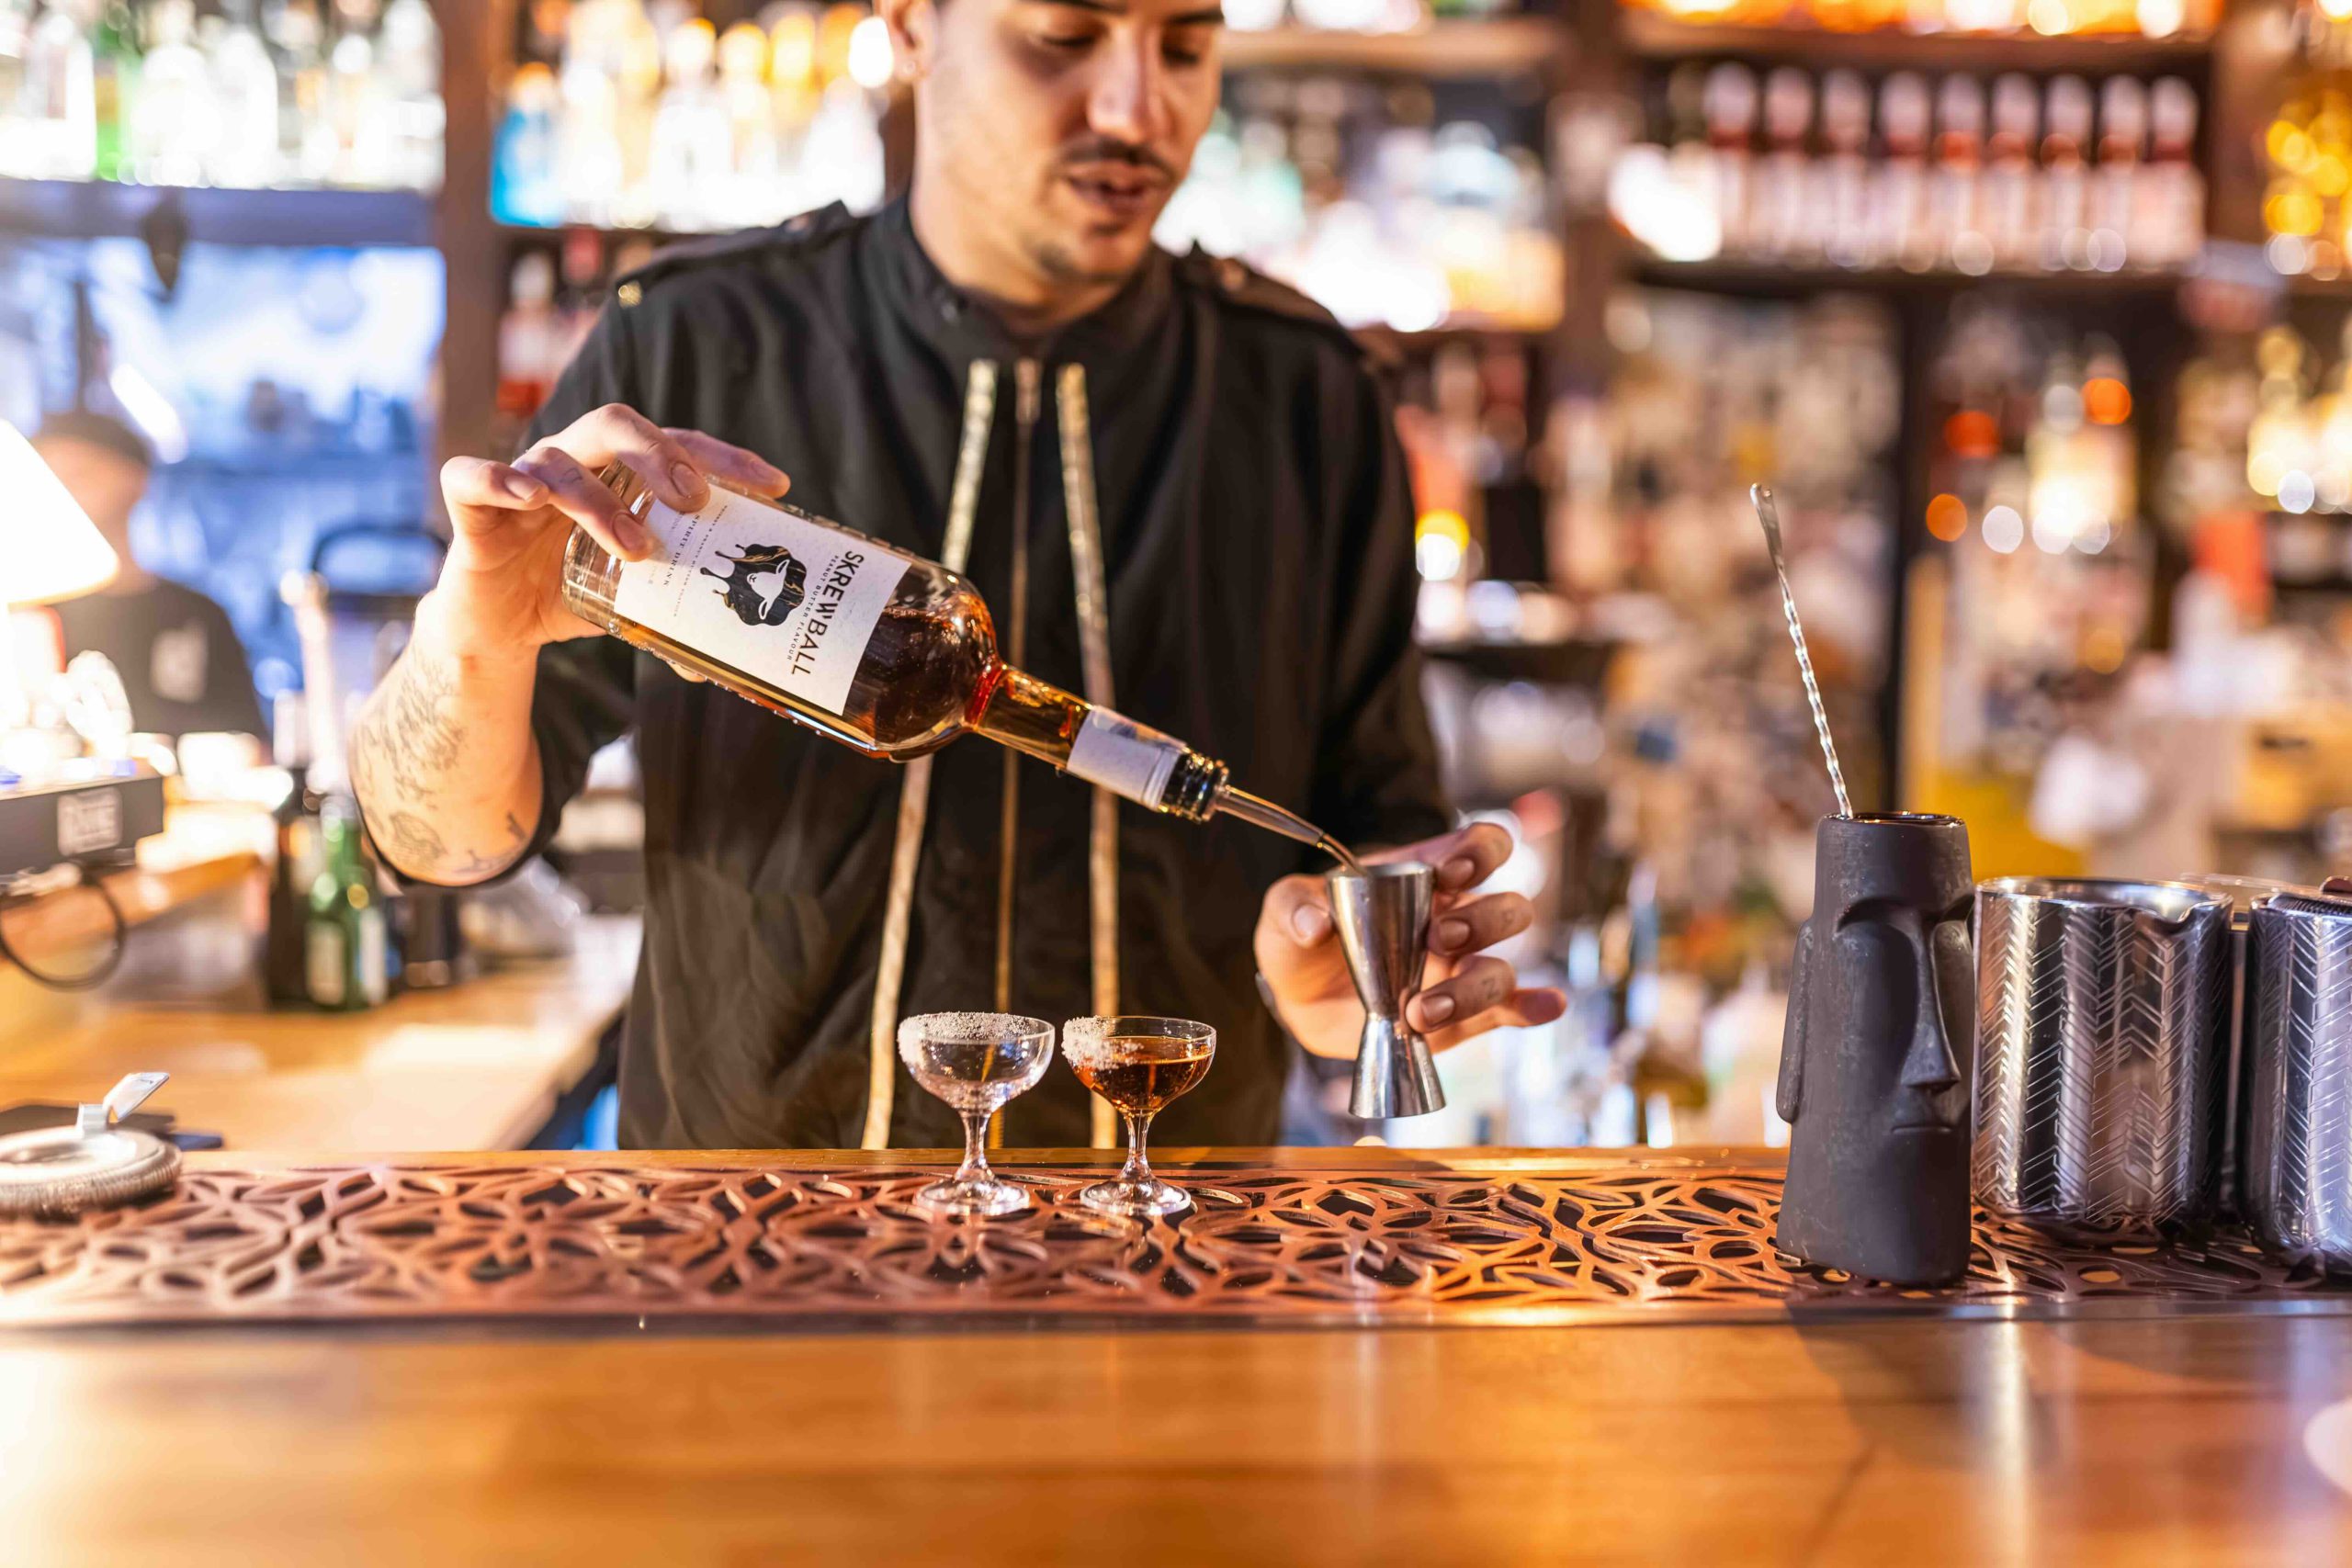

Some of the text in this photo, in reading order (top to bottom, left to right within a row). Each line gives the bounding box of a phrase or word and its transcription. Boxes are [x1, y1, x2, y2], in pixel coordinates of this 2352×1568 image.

[679, 514, 700, 548] SPIRIT
[663, 551, 681, 586] DRINK
[786, 554, 839, 660] PEANUT BUTTER FLAVOUR
[791, 550, 865, 675] SKREWBALL
